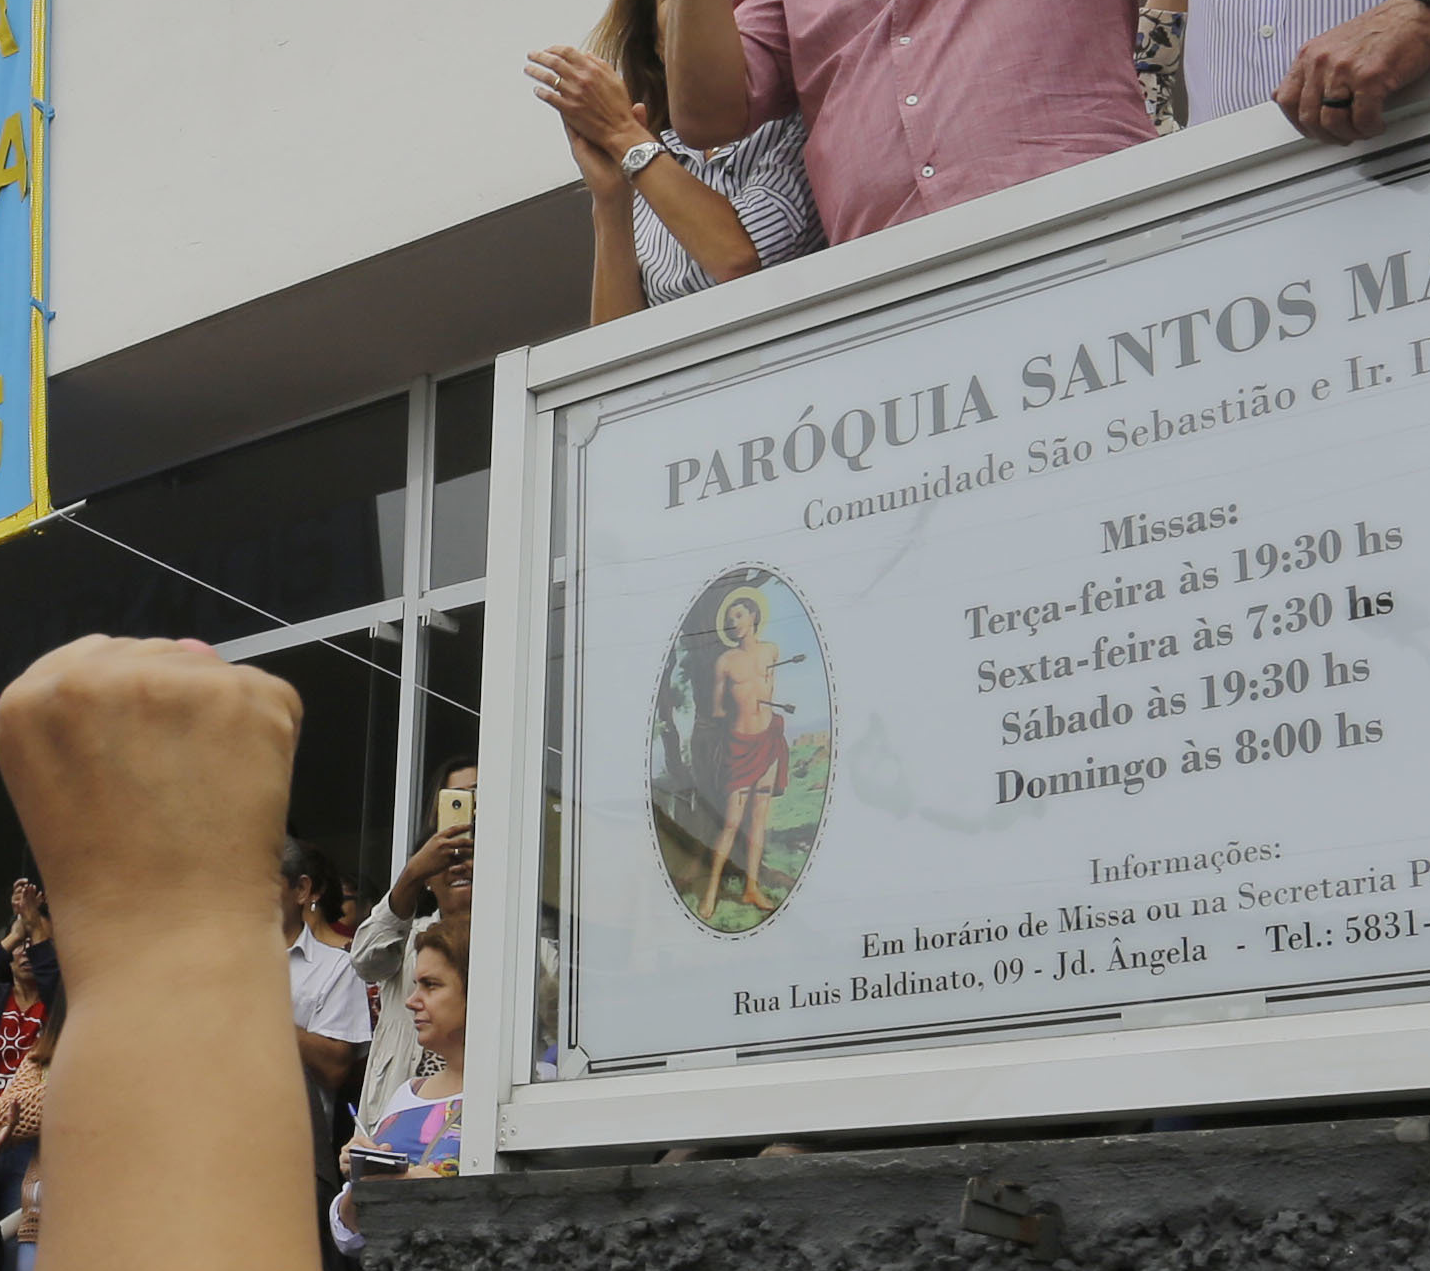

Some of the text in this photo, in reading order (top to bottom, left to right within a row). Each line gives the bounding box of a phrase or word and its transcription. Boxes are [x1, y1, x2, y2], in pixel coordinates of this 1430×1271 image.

[665, 375, 998, 509] PARÓQUIA
[1022, 279, 1316, 411] SANTOS
[804, 453, 1014, 530] Comunidade
[1028, 437, 1092, 473] São
[1107, 384, 1295, 453] Sebastião
[1311, 379, 1330, 400] e
[1344, 356, 1392, 393] Ir.
[1100, 504, 1238, 554] Missas:
[964, 521, 1403, 639] Terça-feira às 19:30 hs
[978, 585, 1394, 694] Sexta-feira às 7:30 hs
[1002, 652, 1370, 745] Sábado às 19:30 hs
[995, 712, 1383, 805] Domingo às 8:00 hs
[1089, 841, 1281, 885] Informações:
[861, 933, 905, 958] Em
[913, 919, 1008, 952] horário
[1018, 912, 1048, 938] de
[1057, 905, 1136, 933] Missa
[1147, 903, 1182, 921] ou
[1191, 897, 1227, 916] na
[1238, 867, 1396, 909] Secretaria
[733, 991, 780, 1016] Rua
[789, 982, 841, 1009] Luis
[850, 971, 984, 1001] Baldinato,
[994, 958, 1024, 984] 09
[1053, 949, 1095, 981] Jd.
[1106, 936, 1207, 975] Ângela
[1265, 921, 1332, 952] Tel.:
